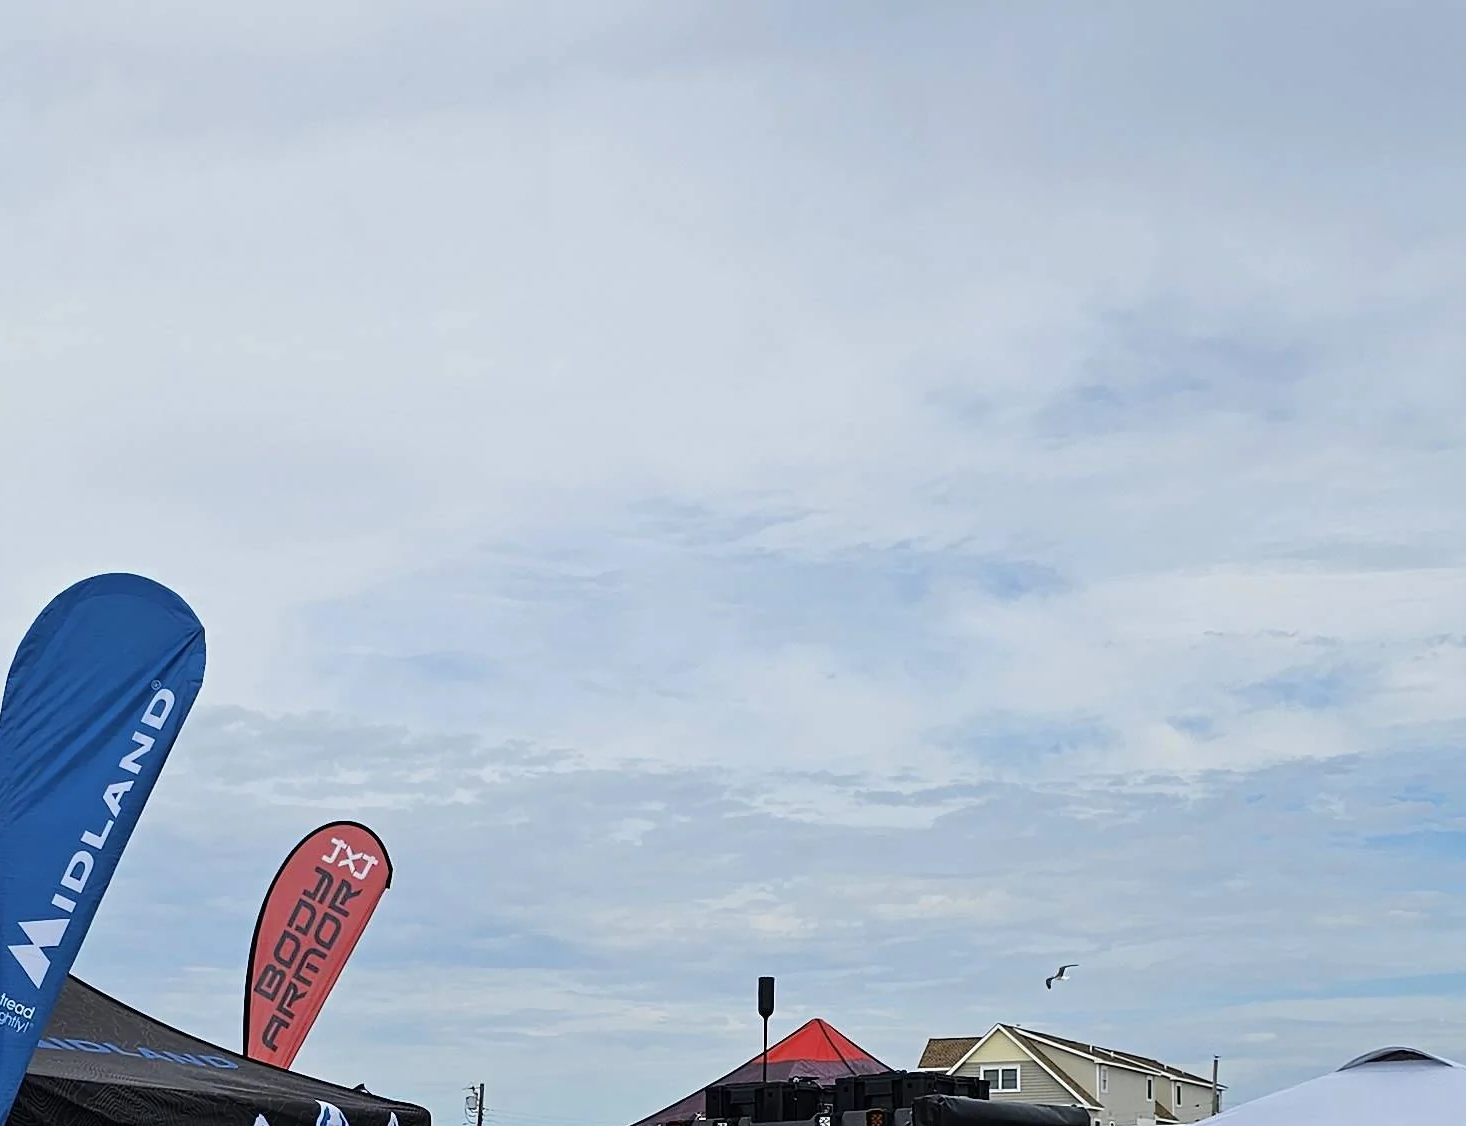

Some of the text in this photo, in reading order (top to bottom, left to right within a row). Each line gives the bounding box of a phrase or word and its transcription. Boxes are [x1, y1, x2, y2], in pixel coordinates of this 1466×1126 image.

[7, 688, 176, 990] MIDLAND
[254, 866, 334, 1002] BODY
[261, 879, 363, 1053] ARMOR
[0, 992, 36, 1019] tread
[37, 1037, 239, 1069] IDLAND
